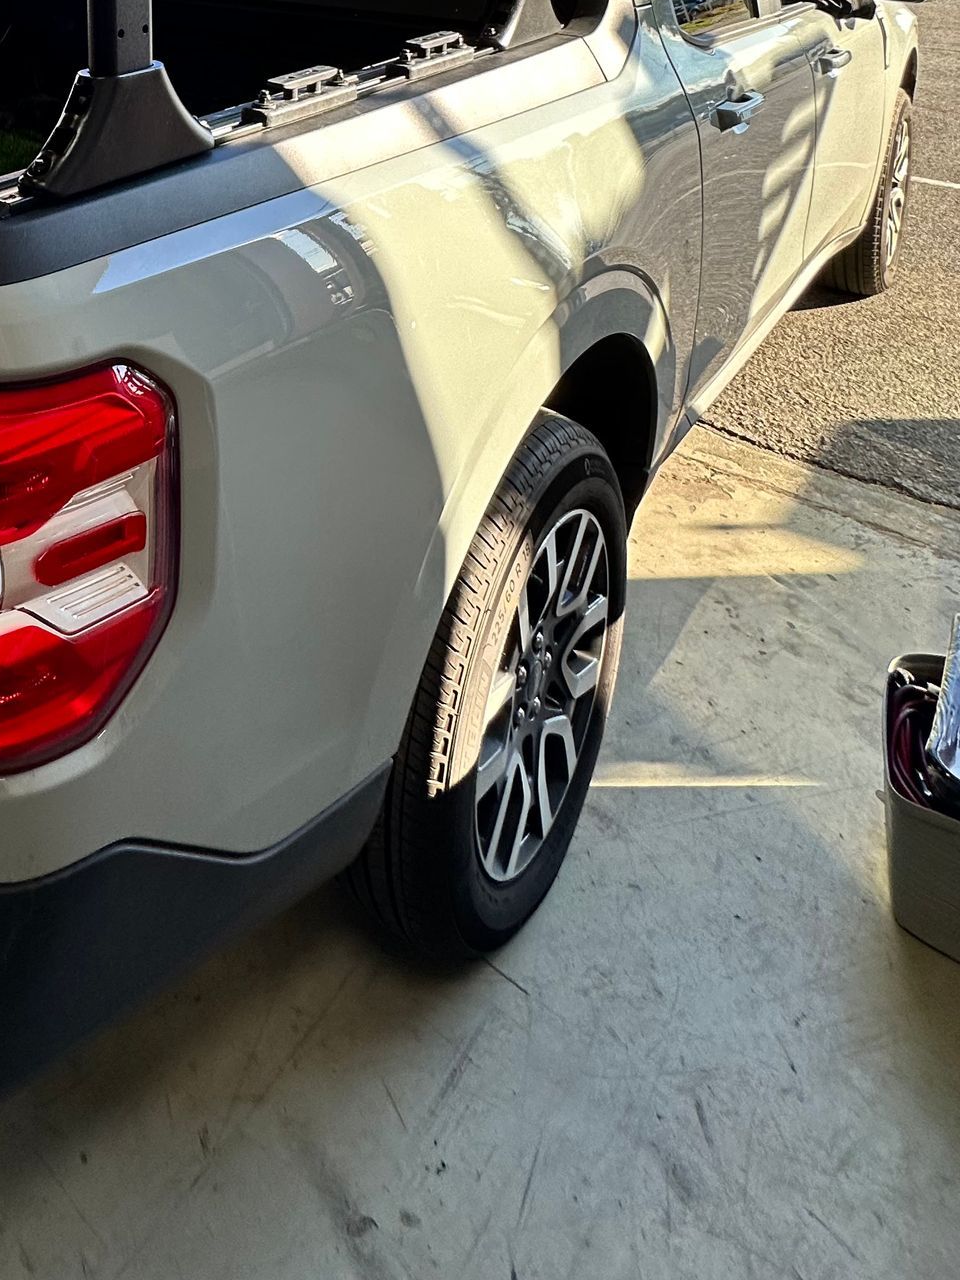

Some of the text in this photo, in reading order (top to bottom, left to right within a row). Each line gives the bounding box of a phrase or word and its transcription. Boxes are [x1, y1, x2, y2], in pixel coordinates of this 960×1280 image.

[492, 542, 531, 646] 225/60 R 18
